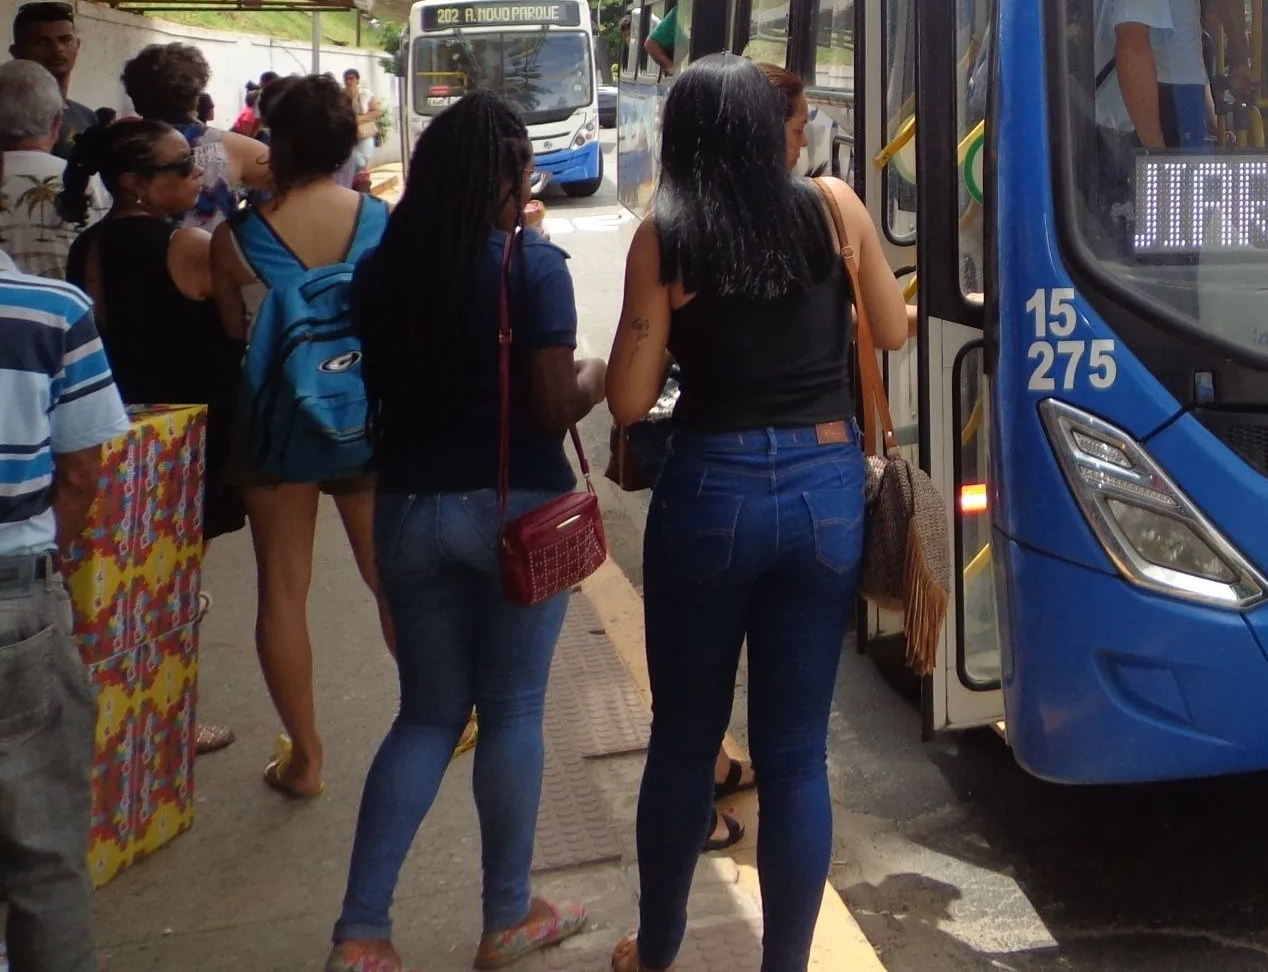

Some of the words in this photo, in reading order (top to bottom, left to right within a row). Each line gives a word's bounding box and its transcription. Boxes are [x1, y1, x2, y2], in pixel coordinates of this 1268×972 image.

[437, 8, 459, 24] 202
[1025, 287, 1078, 338] 15
[1027, 339, 1118, 391] 275
